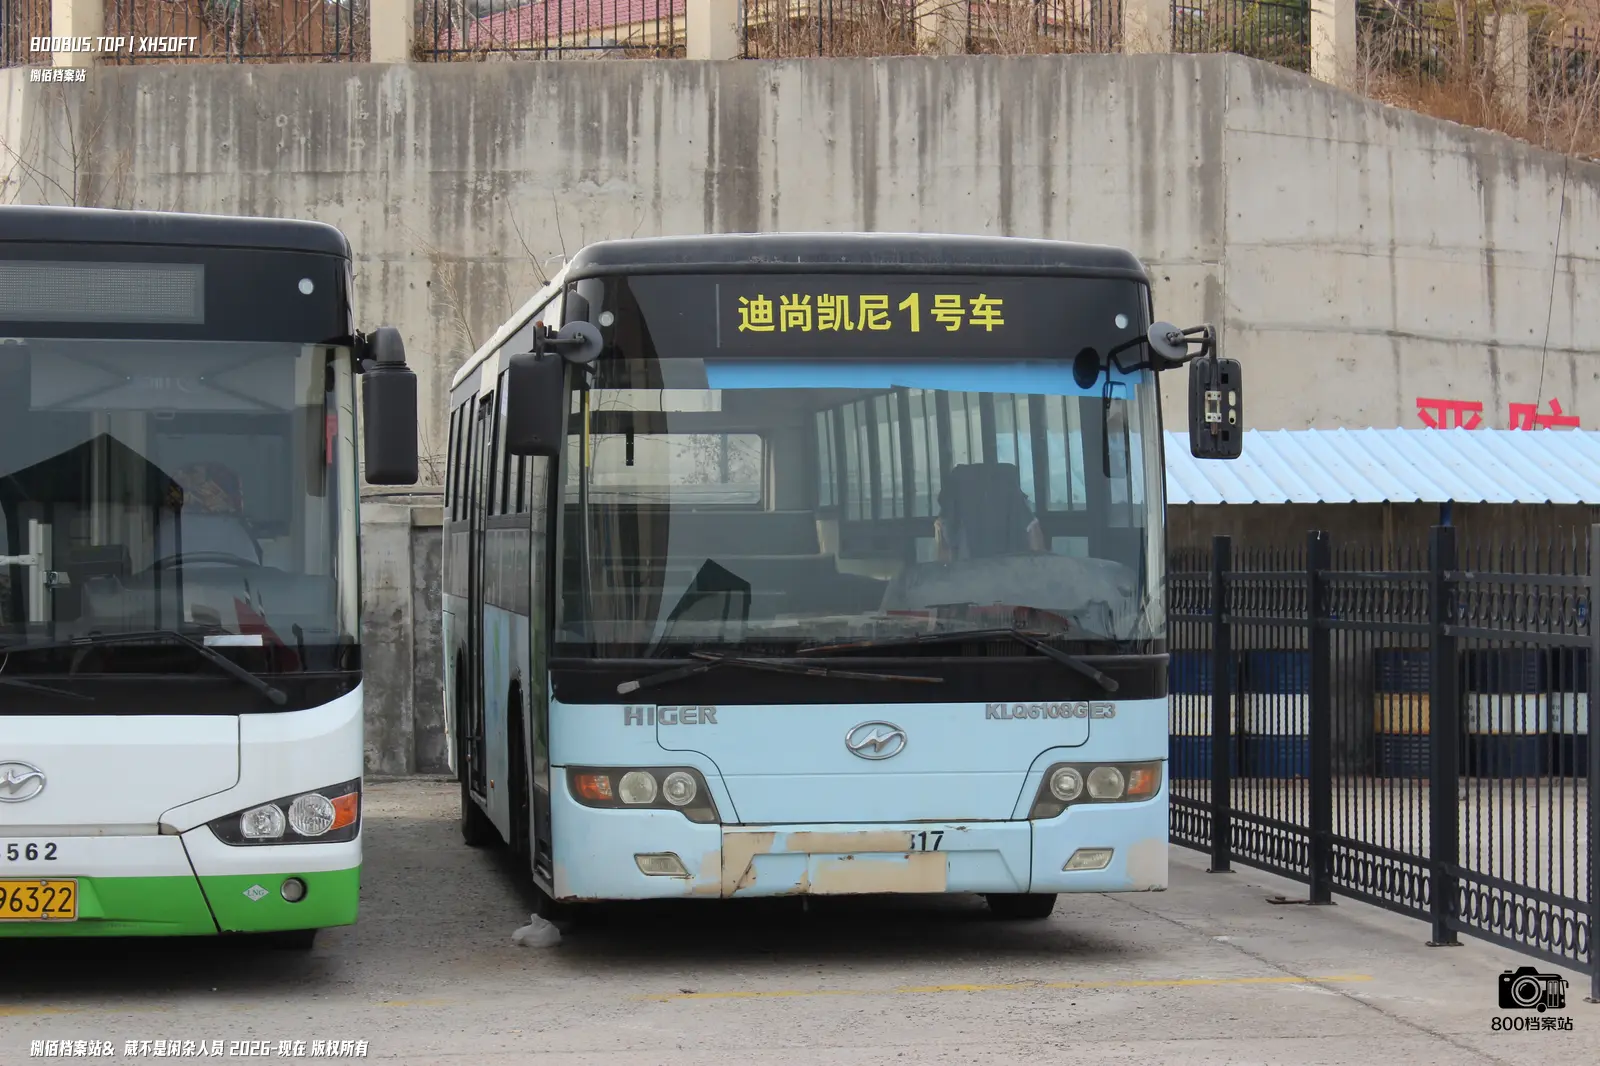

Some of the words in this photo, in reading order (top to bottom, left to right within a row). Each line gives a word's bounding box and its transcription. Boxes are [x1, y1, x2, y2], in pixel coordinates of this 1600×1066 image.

[738, 292, 1005, 333] 迪尚凯尼1号车
[624, 705, 718, 726] HIGER
[910, 830, 945, 851] 17
